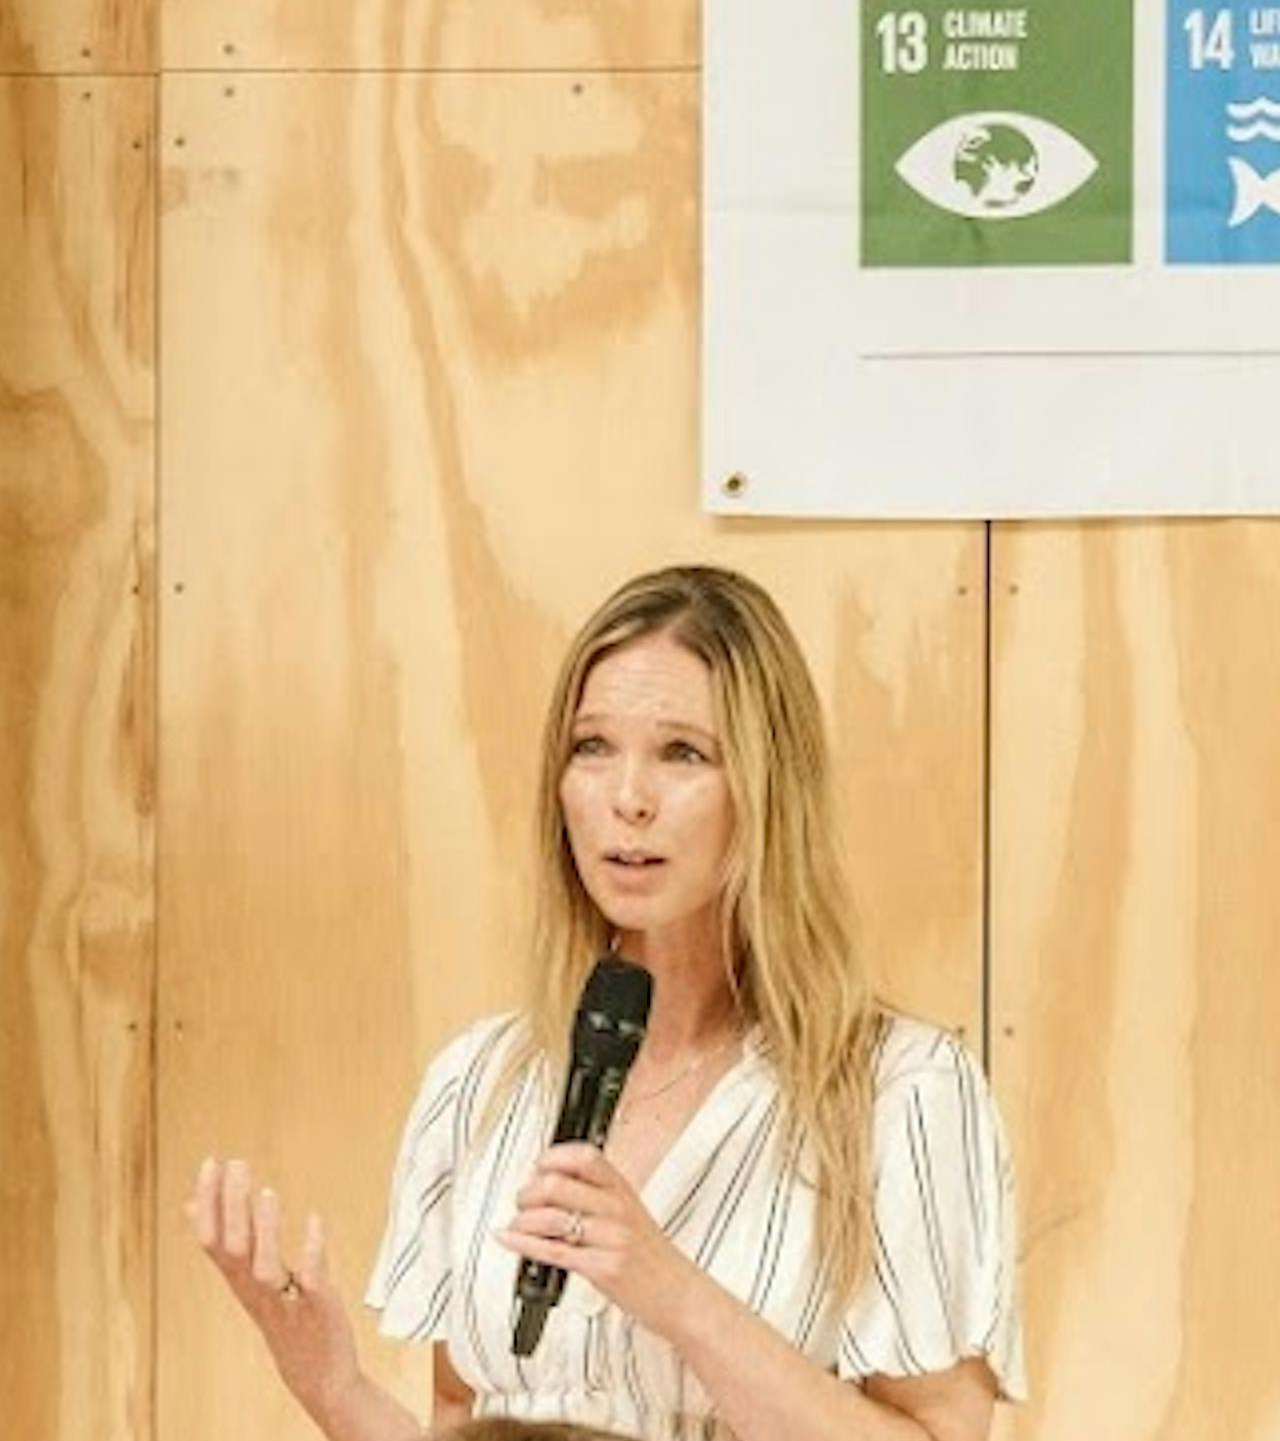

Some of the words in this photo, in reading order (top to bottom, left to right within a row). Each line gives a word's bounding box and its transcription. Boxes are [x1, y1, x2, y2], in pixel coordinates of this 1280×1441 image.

[875, 10, 929, 74] 13
[942, 8, 1029, 39] CLIMATE
[1183, 8, 1236, 71] 14
[941, 42, 1019, 71] ACTION
